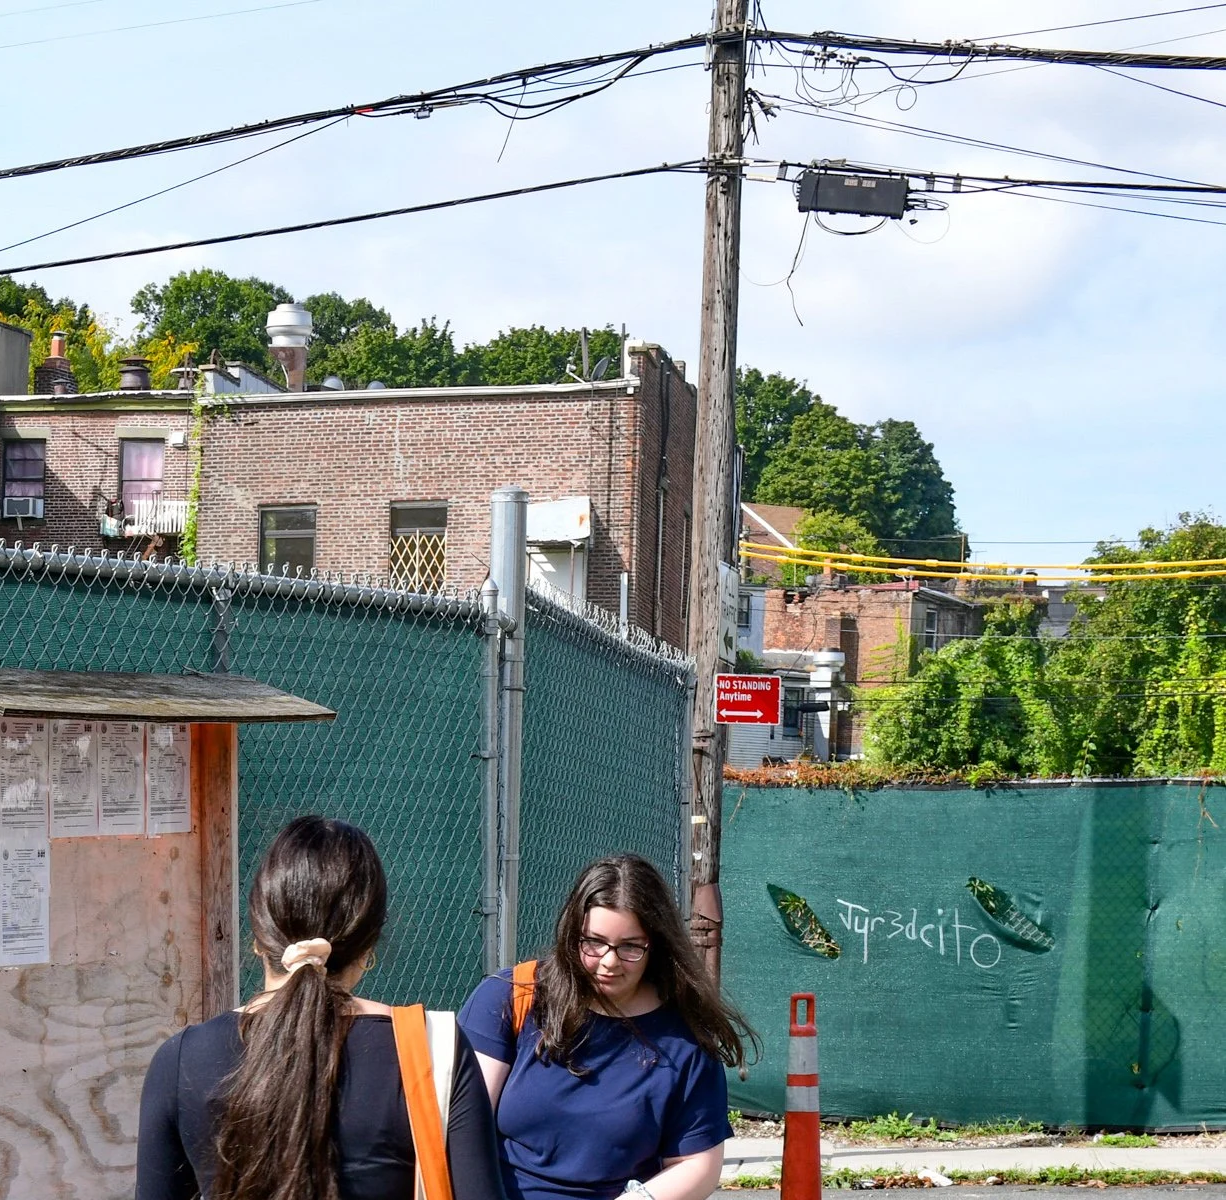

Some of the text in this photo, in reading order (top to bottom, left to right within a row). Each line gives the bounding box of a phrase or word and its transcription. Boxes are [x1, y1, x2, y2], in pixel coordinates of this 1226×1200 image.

[719, 680, 771, 691] NO STANDING
[719, 691, 752, 702] Anytime
